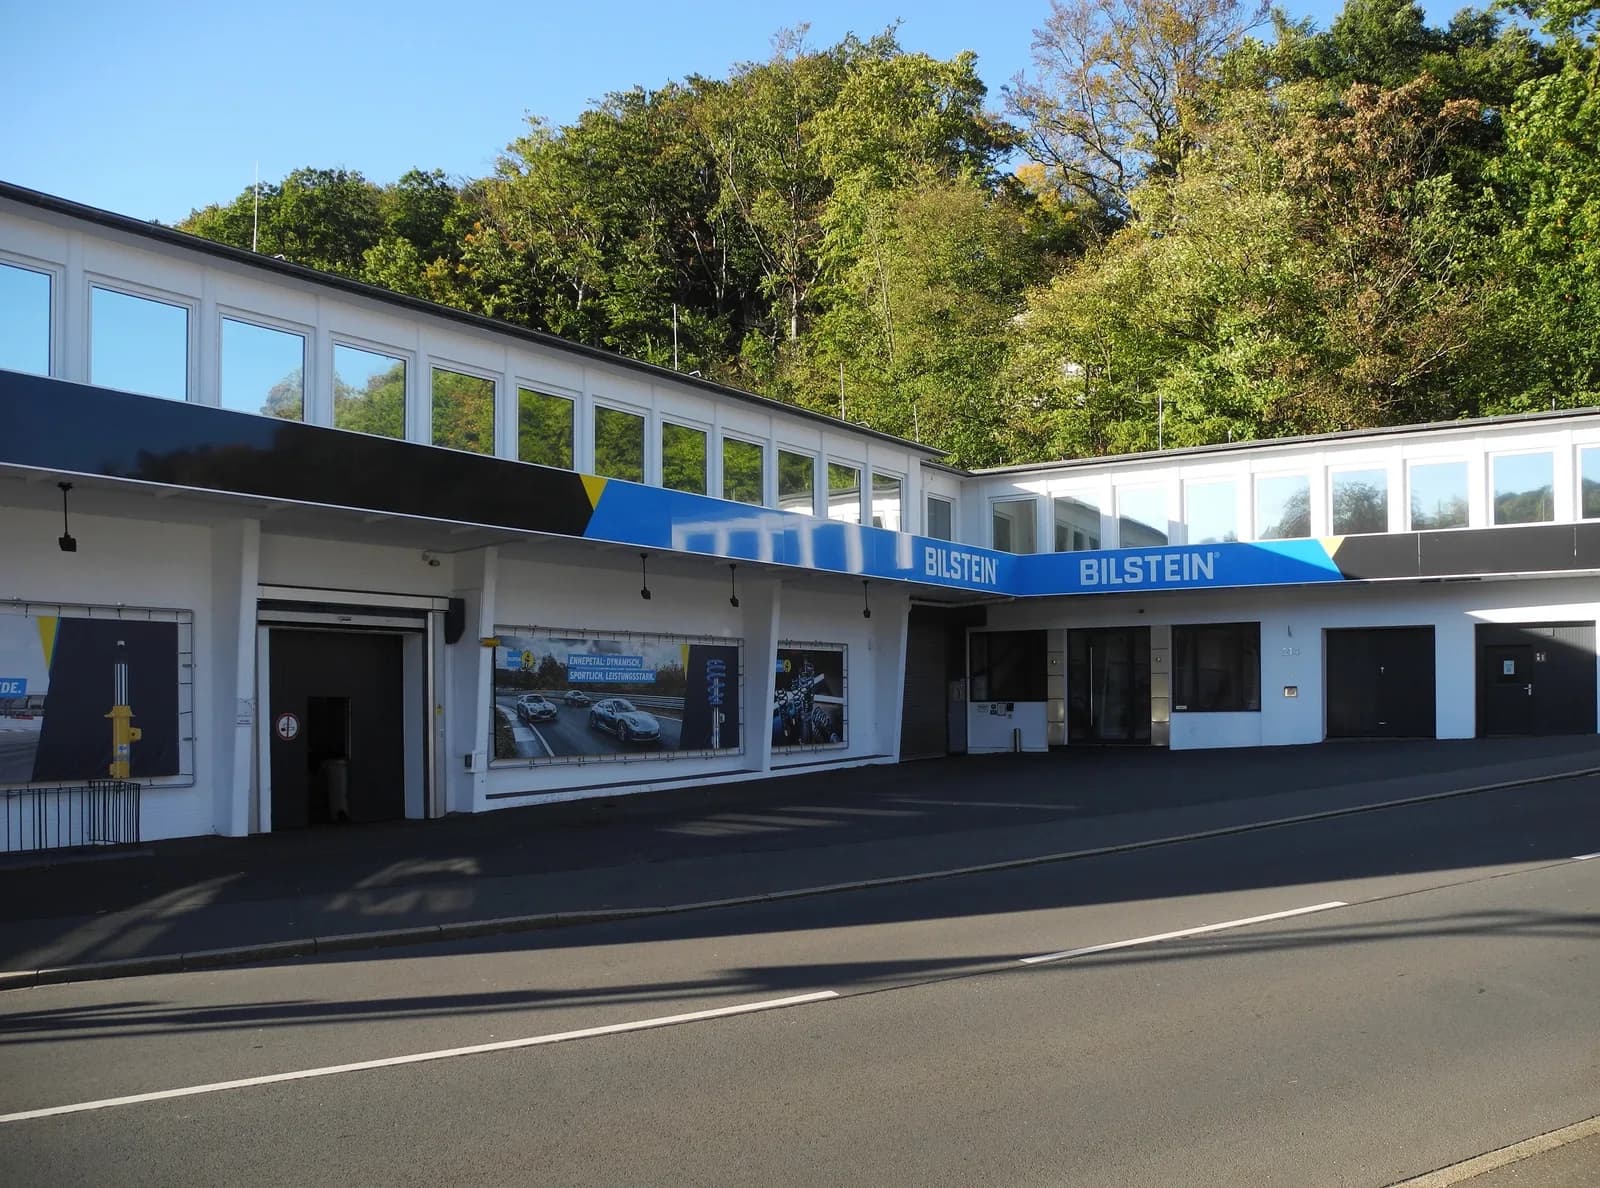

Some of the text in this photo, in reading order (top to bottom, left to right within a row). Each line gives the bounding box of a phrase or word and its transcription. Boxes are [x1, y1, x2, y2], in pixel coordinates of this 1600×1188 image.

[925, 546, 996, 585] BILSTEIN
[1080, 551, 1215, 586] BILSTEIN
[0, 681, 21, 694] DE.
